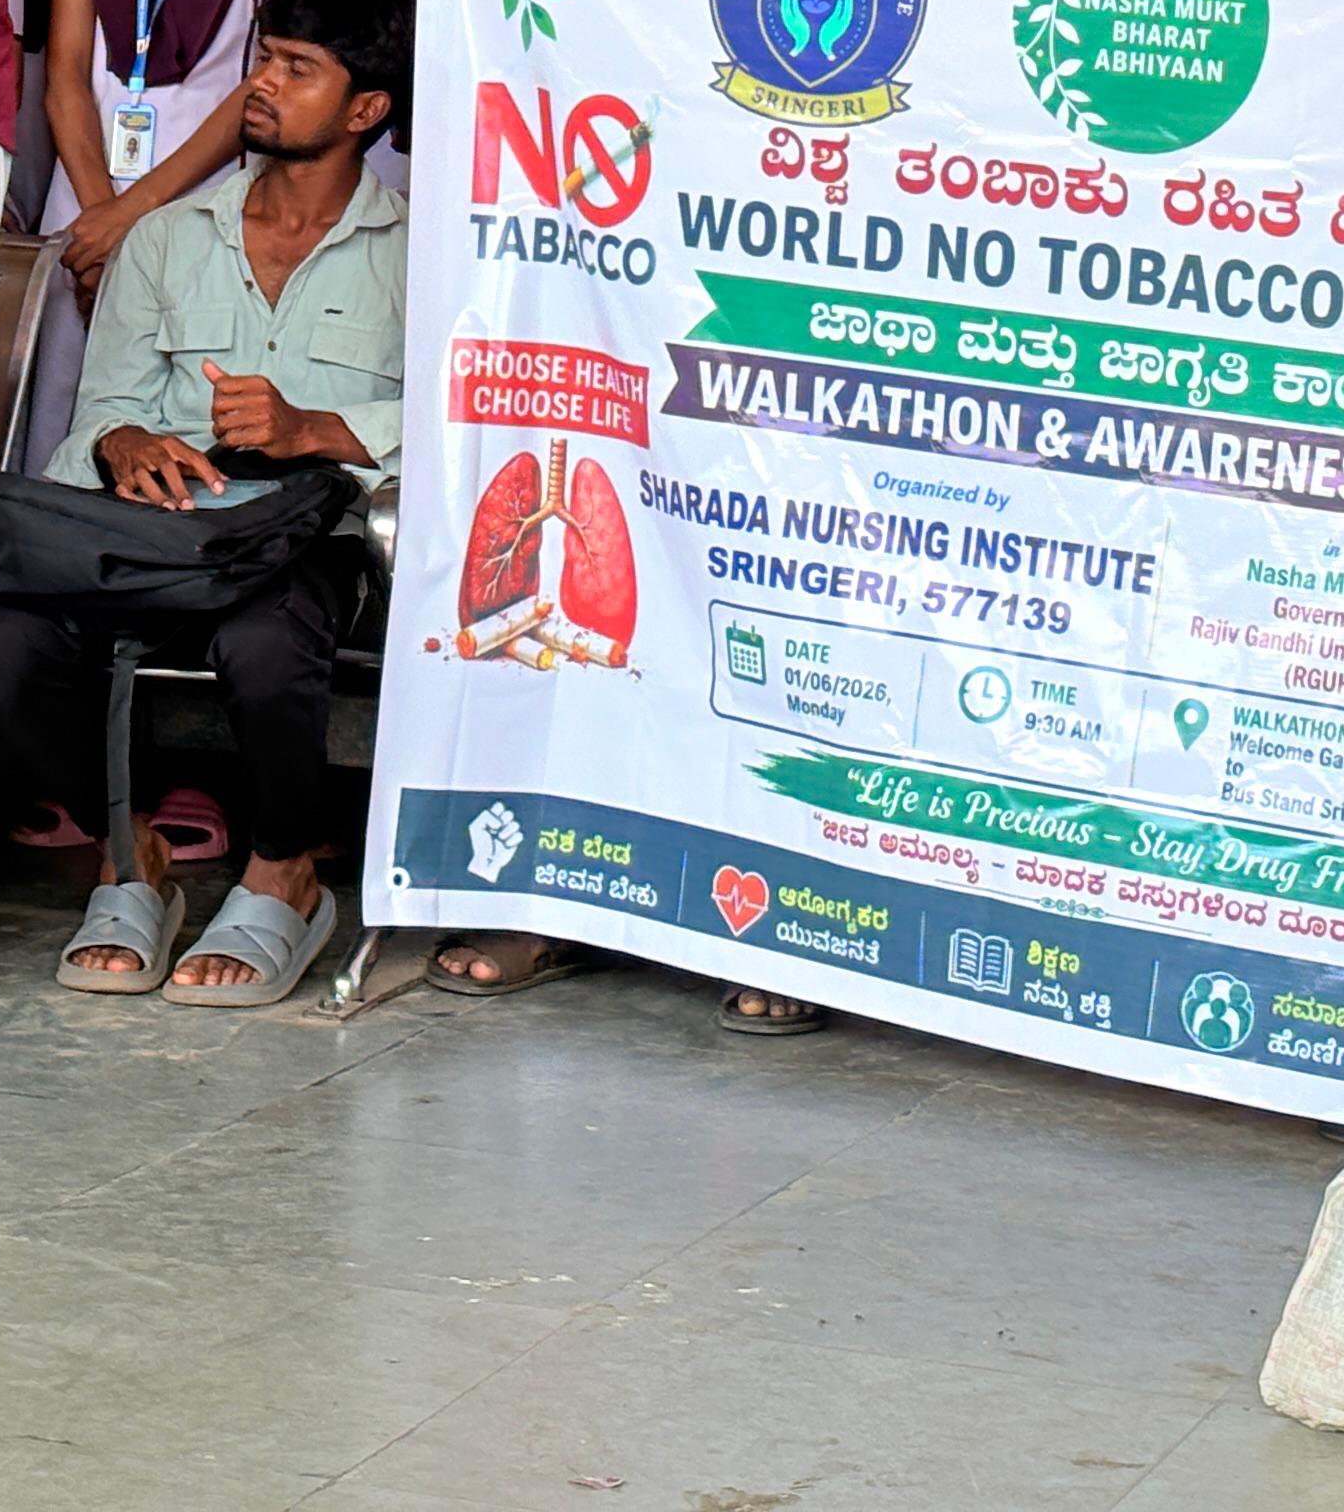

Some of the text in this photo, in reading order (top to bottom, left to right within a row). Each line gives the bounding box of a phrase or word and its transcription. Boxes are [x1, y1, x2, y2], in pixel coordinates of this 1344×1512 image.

[1112, 20, 1212, 51] BHARAT
[1094, 48, 1224, 82] ABHIYAAN
[751, 86, 867, 119] SRINGERI
[471, 81, 653, 229] NO
[761, 127, 851, 206] ವಿಶ್ವ
[894, 141, 1130, 217] ತಂಬಾಕು
[1163, 171, 1304, 239] ರಹಿತ
[469, 214, 657, 286] TABACCO
[677, 192, 905, 273] WORLD
[927, 222, 1015, 289] NO
[1038, 236, 1344, 331] TOBACCO
[810, 300, 937, 356] ಜಾಥಾ
[957, 316, 1079, 388] ಮತ್ತು
[1099, 337, 1251, 408] ಜಾಗೃತಿ
[454, 348, 645, 405] CHOOSE HEALTH
[473, 387, 633, 435] CHOOSE LIFE
[699, 359, 1020, 452] WALKATHON
[1034, 406, 1074, 460] &
[872, 469, 1011, 513] Organized by
[639, 468, 1158, 596] SHARADA NURSING INSTITUTE
[1322, 538, 1341, 560] in
[707, 545, 1073, 636] SRINGERI, 577139
[1245, 557, 1318, 593] Nasha
[785, 638, 831, 665] DATE
[1189, 615, 1239, 652] Rajiv
[1244, 624, 1314, 659] Gandhi
[783, 669, 892, 708] 01/06/2026,
[1030, 680, 1077, 706] TIME
[786, 695, 846, 727] Monday
[1024, 712, 1102, 742] 9:30 AM
[1225, 757, 1244, 778] to
[1229, 732, 1314, 769] Welcome
[1221, 782, 1254, 807] Bus
[1258, 785, 1316, 818] Stand
[582, 834, 632, 866] ಬೇಡ
[928, 786, 954, 819] is
[963, 790, 1094, 848] Precious
[1130, 823, 1206, 874] Stay
[1214, 834, 1303, 892] Drug
[535, 863, 657, 908] ಜೀವನ ಬೇಕು
[878, 831, 981, 884] ಅಮೂಲ್ಯ
[1015, 855, 1108, 896] ಮಾದಕ
[1118, 878, 1269, 927] ವಸ್ತುಗಳಿಂದ
[779, 885, 889, 934] ಆರೋಗ್ಯಕರ
[776, 922, 880, 966] ಯುವಜನತೆ
[1027, 940, 1080, 978] ಶಿಕ್ಷಣ
[1023, 981, 1112, 1029] ನಮ್ಮ ಶಕ್ತಿ
